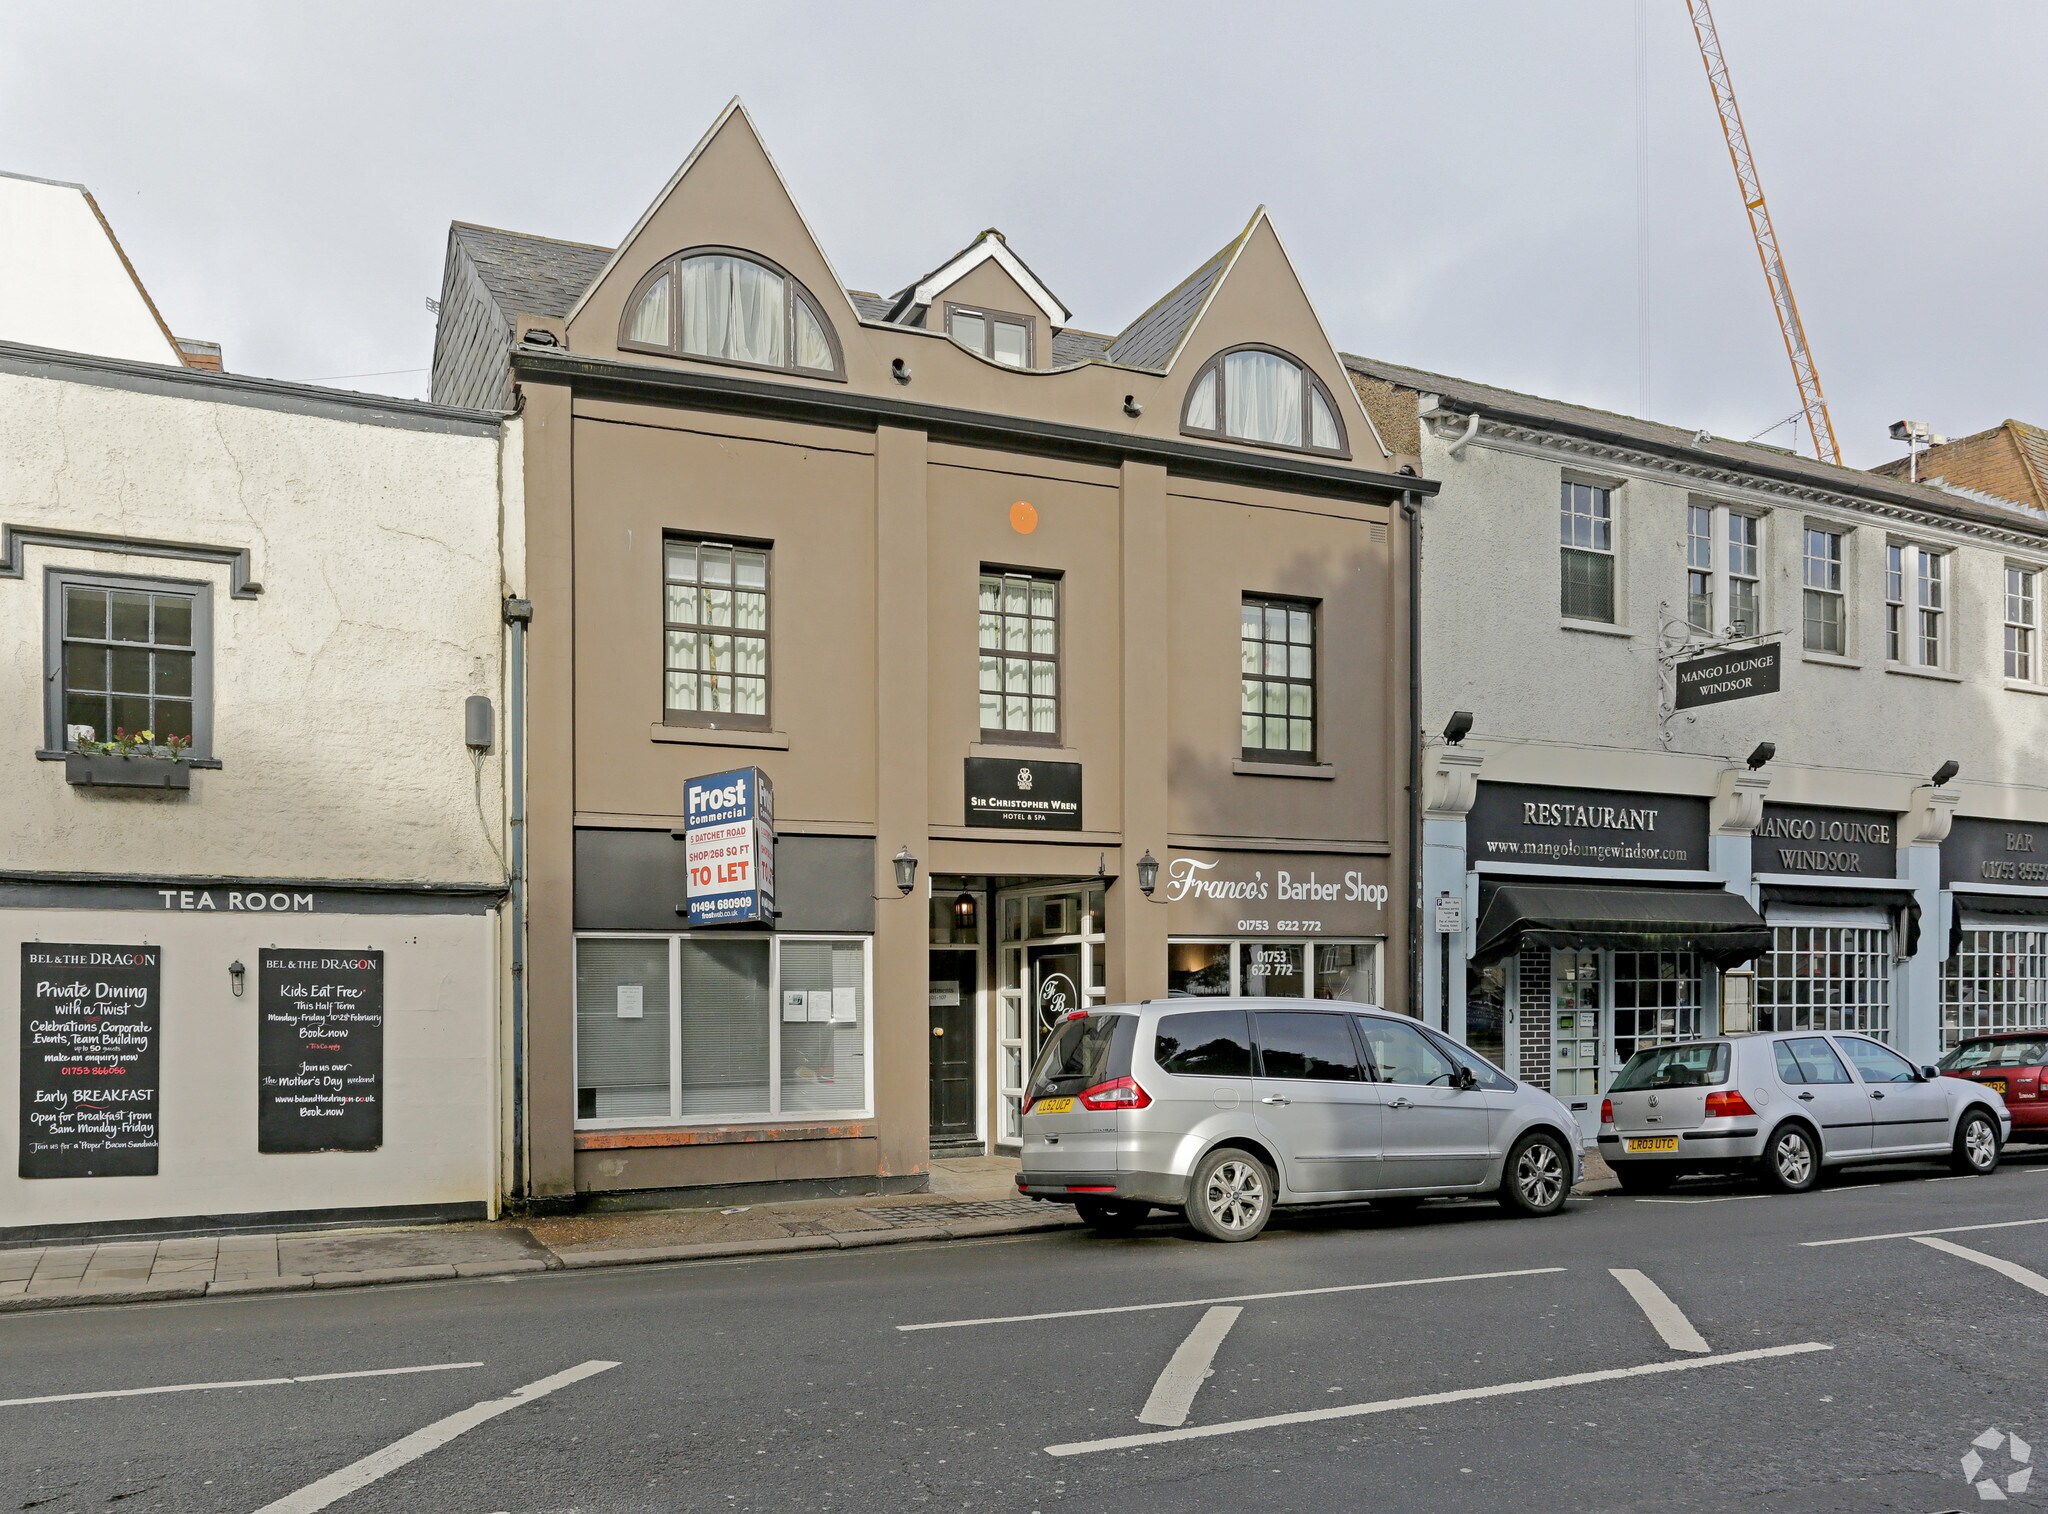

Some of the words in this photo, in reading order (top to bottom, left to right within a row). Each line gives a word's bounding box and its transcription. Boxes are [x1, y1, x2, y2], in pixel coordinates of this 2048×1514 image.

[1681, 666, 1723, 684] MANGO
[1725, 655, 1774, 675] LOUNGE
[1700, 677, 1752, 696] WINDSOR
[689, 779, 746, 814] Frost
[690, 806, 746, 826] Commercial
[1002, 813, 1025, 821] HOTEL
[1522, 802, 1658, 831] RESTAURANT
[696, 830, 724, 842] DATCHET
[726, 827, 746, 839] ROAD
[1750, 816, 1816, 841] MANGO
[1820, 820, 1890, 845] LOUNGE
[726, 847, 738, 856] SQ
[740, 844, 749, 855] FT
[1486, 838, 1688, 861] www.mangoloungewindsor.com
[2005, 832, 2035, 853] BAR
[1779, 848, 1861, 873] WINDSOR
[691, 866, 711, 887] TO
[717, 861, 749, 883] LET
[1981, 860, 2015, 879] 01753
[1166, 858, 1269, 902] Franco's
[1277, 871, 1341, 901] Barber
[1344, 871, 1388, 911] Shop
[158, 890, 216, 910] TEA
[228, 892, 313, 911] ROOM
[691, 902, 716, 913] 01494
[717, 896, 752, 910] 680909
[701, 910, 738, 920] frostweb.co.uk
[1238, 920, 1270, 931] 01753
[1277, 920, 1300, 931] 622
[1301, 921, 1322, 931] 772
[30, 954, 53, 963] BEL
[62, 954, 88, 965] THE
[89, 952, 156, 967] DRAGON
[266, 960, 286, 969] BEL
[297, 960, 319, 970] THE
[321, 959, 377, 970] DRAGON
[1256, 951, 1286, 963] 01753
[1251, 964, 1271, 976] 622
[1274, 964, 1292, 976] 772
[36, 981, 91, 998] Private
[95, 982, 148, 1009] Dining
[280, 983, 308, 998] Kids
[310, 985, 335, 998] Eat
[54, 998, 82, 1015] with
[83, 1005, 96, 1015] a
[93, 1000, 131, 1016] Twist
[293, 1001, 314, 1010] This
[315, 1000, 333, 1017] Half
[334, 1001, 355, 1010] Term
[101, 1021, 152, 1037] Corporate
[350, 1013, 382, 1028] February
[299, 1027, 328, 1039] Book
[327, 1029, 349, 1039] now
[32, 1033, 71, 1047] Events,
[70, 1033, 100, 1044] Team
[102, 1034, 148, 1052] Building
[44, 1053, 70, 1063] make
[84, 1054, 118, 1068] enquiry
[120, 1054, 139, 1062] now
[297, 1061, 318, 1077] Join
[319, 1064, 330, 1072] us
[331, 1063, 353, 1072] over
[61, 1067, 91, 1076] 01753
[278, 1076, 321, 1087] Mother's
[323, 1076, 344, 1092] Day
[346, 1073, 375, 1085] weekend
[34, 1090, 68, 1111] Early
[71, 1089, 154, 1103] BREAKFAST
[30, 1111, 57, 1127] Open
[58, 1111, 75, 1125] for
[76, 1110, 129, 1126] Breakfast
[127, 1111, 152, 1125] from
[299, 1106, 326, 1118] Book
[325, 1108, 344, 1117] now
[49, 1123, 75, 1135] 8am
[29, 1141, 49, 1154] Join
[60, 1142, 73, 1154] for
[105, 1141, 127, 1149] Bacon
[127, 1139, 159, 1149] Sandwich
[1631, 1140, 1654, 1150] LR03
[1655, 1139, 1674, 1149] UTC
